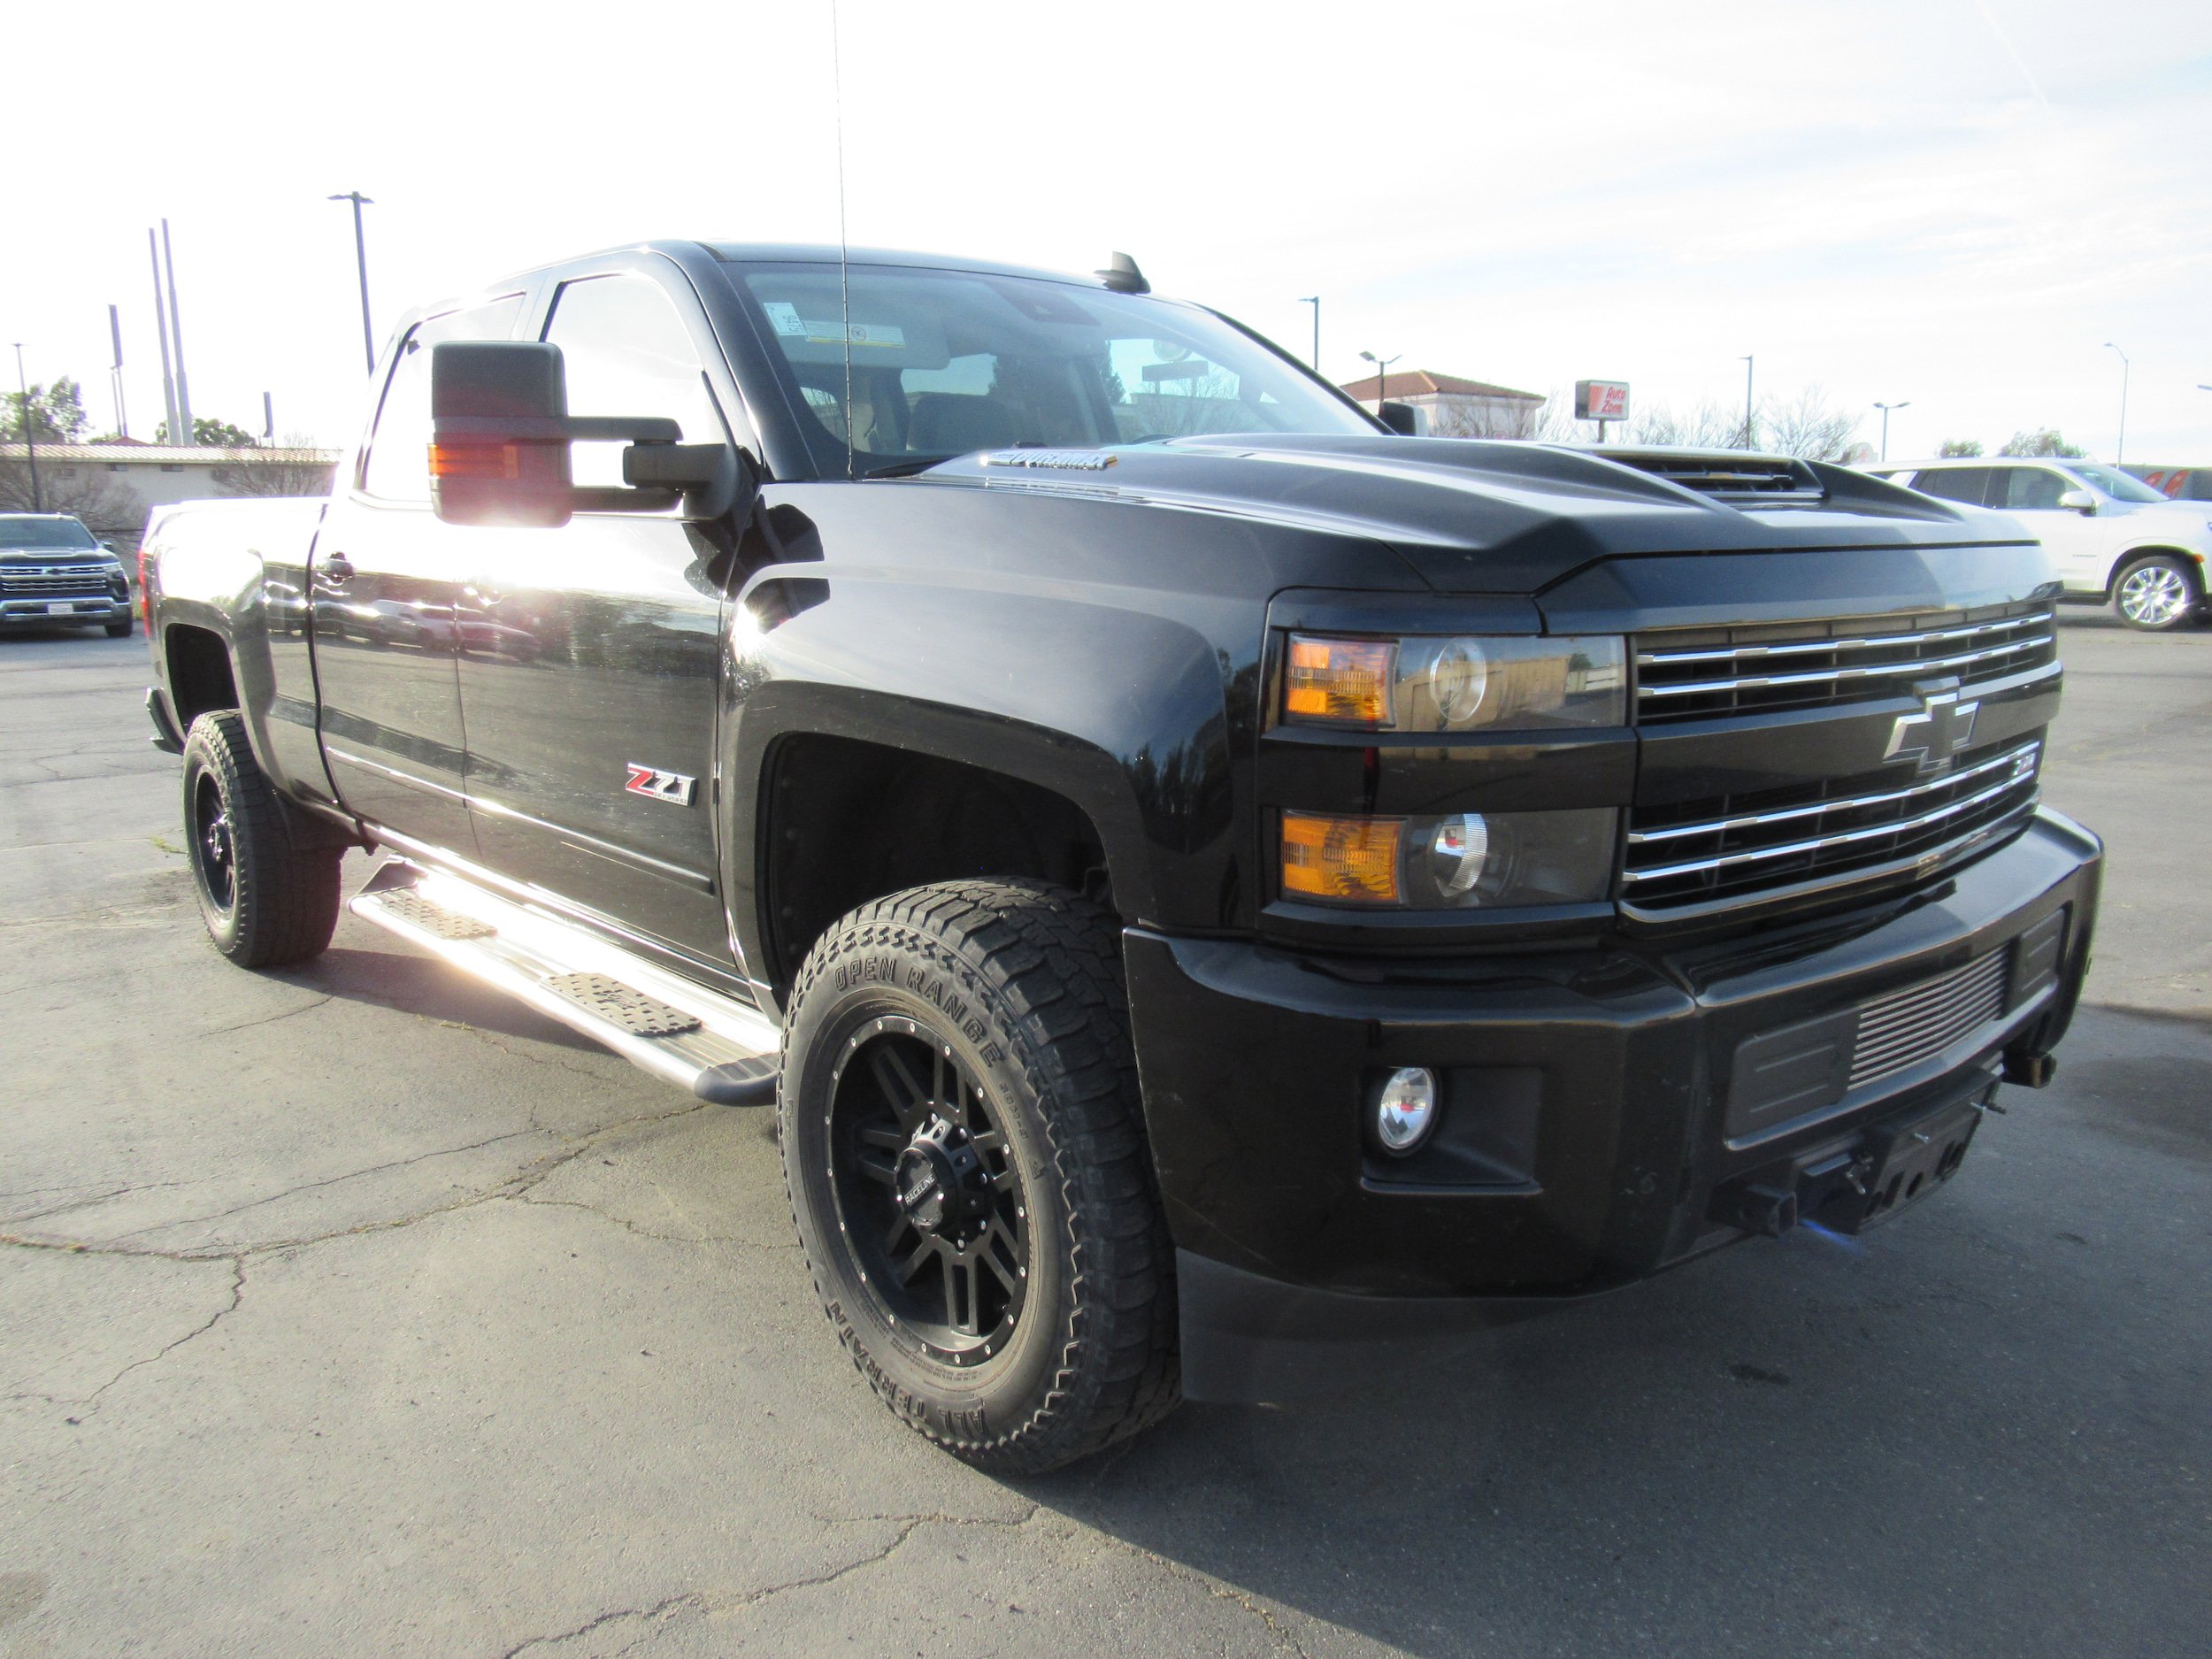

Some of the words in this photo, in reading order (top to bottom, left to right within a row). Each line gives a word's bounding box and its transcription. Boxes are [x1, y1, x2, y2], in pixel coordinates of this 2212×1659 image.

[1601, 400, 1623, 414] Zone
[1606, 386, 1626, 399] Auto
[625, 763, 695, 806] Z71
[834, 956, 897, 992] OPEN
[906, 965, 1005, 1069] RANGE
[904, 1173, 935, 1206] RACELINE
[829, 1302, 928, 1423] TERRAIN
[937, 1405, 984, 1434] ALL
